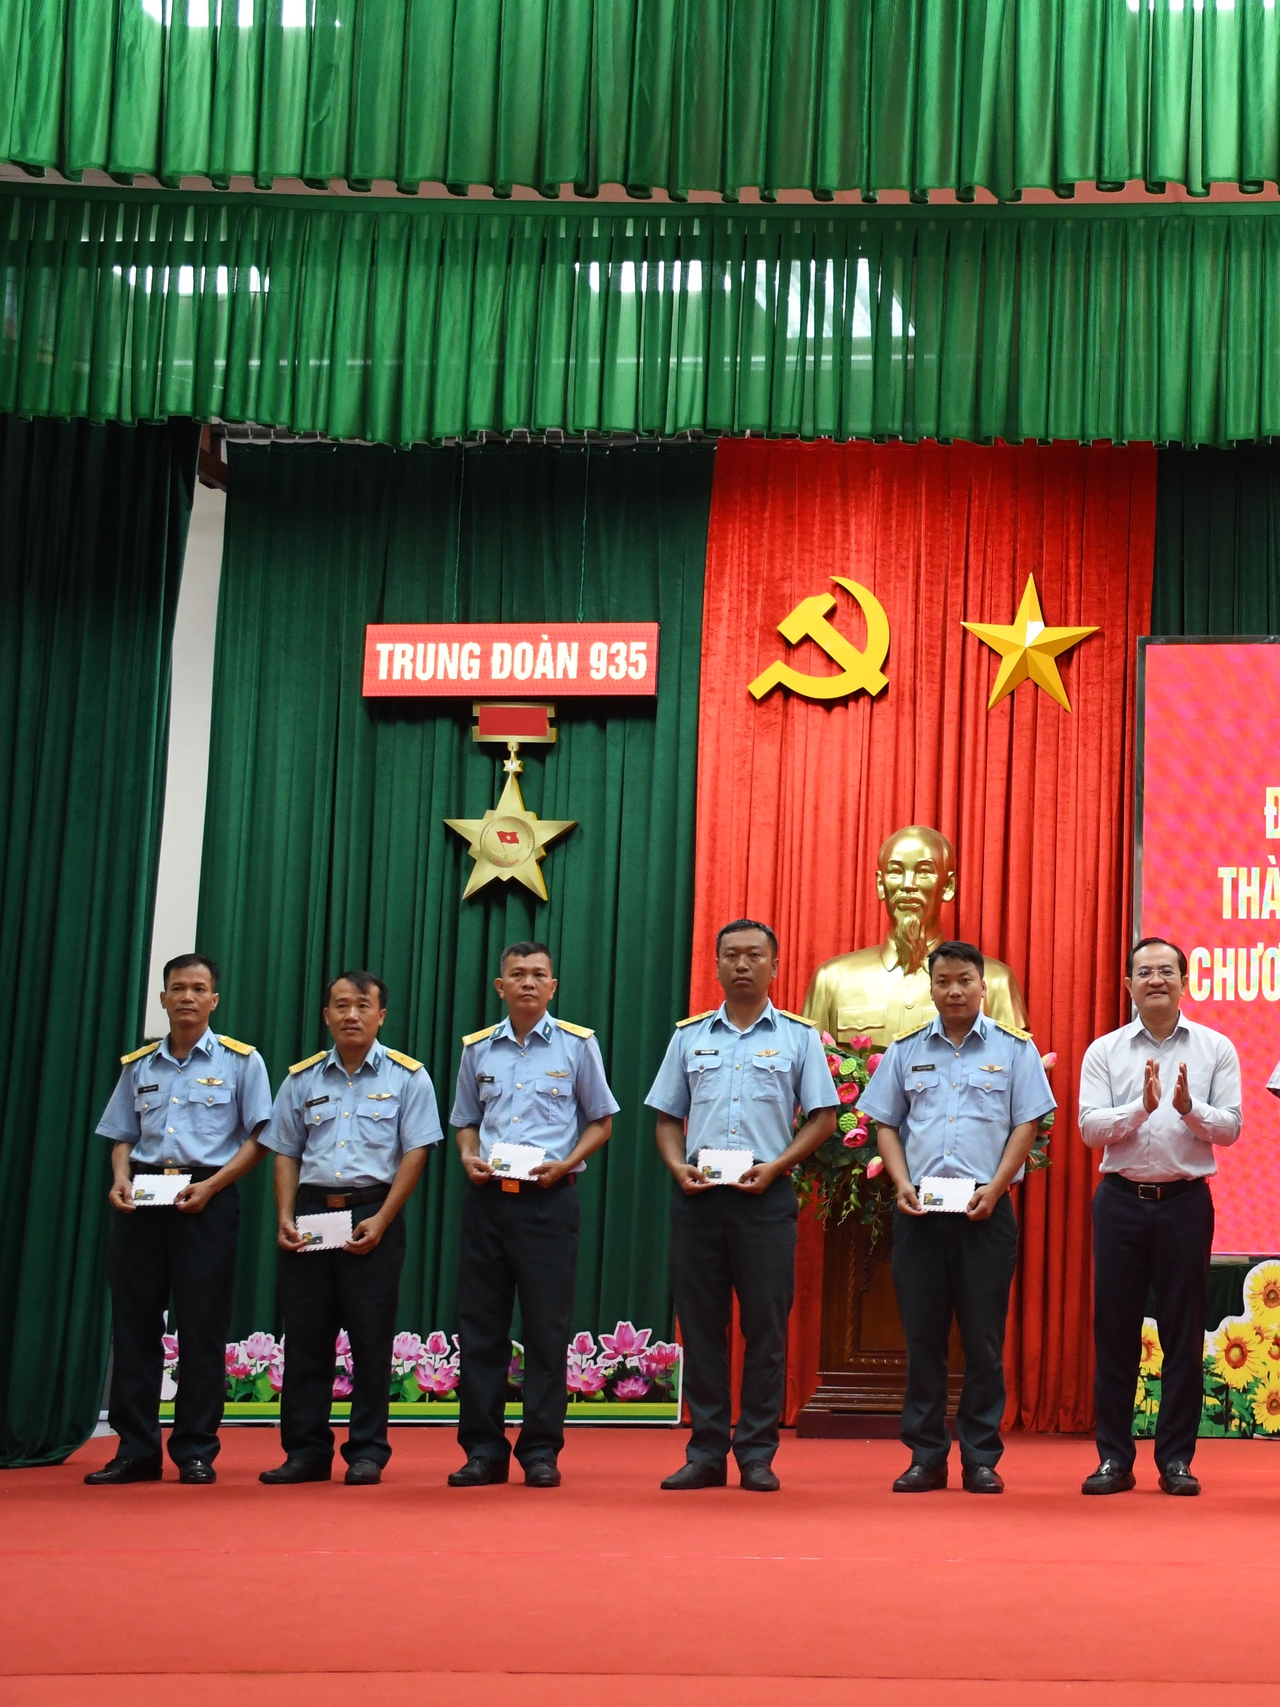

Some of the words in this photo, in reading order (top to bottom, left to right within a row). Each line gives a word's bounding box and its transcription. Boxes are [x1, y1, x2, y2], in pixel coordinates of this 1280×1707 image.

[376, 642, 481, 681] TRUNG
[491, 634, 579, 680] ĐOÀN
[589, 642, 647, 680] 935
